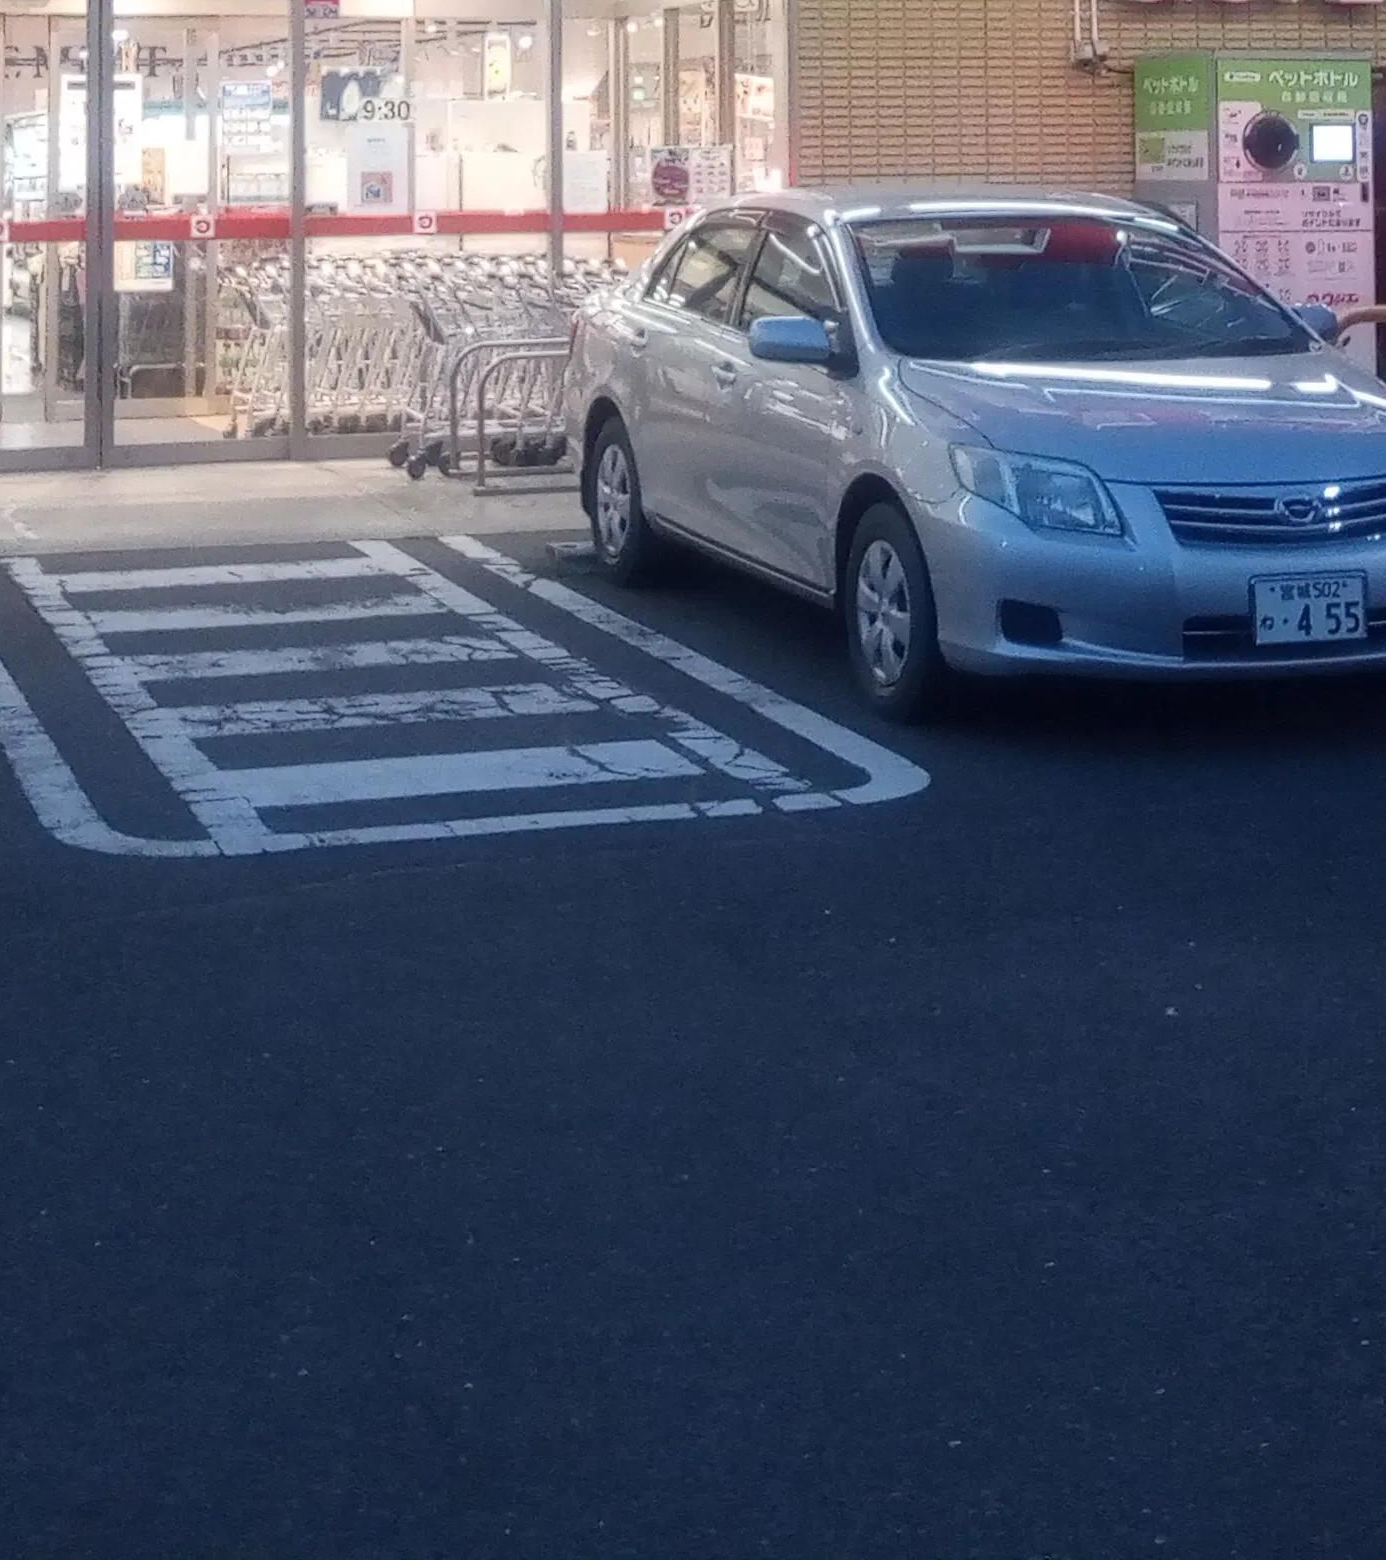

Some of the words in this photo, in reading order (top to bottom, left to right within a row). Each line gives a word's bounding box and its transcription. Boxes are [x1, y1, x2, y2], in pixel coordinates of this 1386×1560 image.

[1268, 69, 1359, 88] ペットボトル
[363, 99, 411, 121] 9:30
